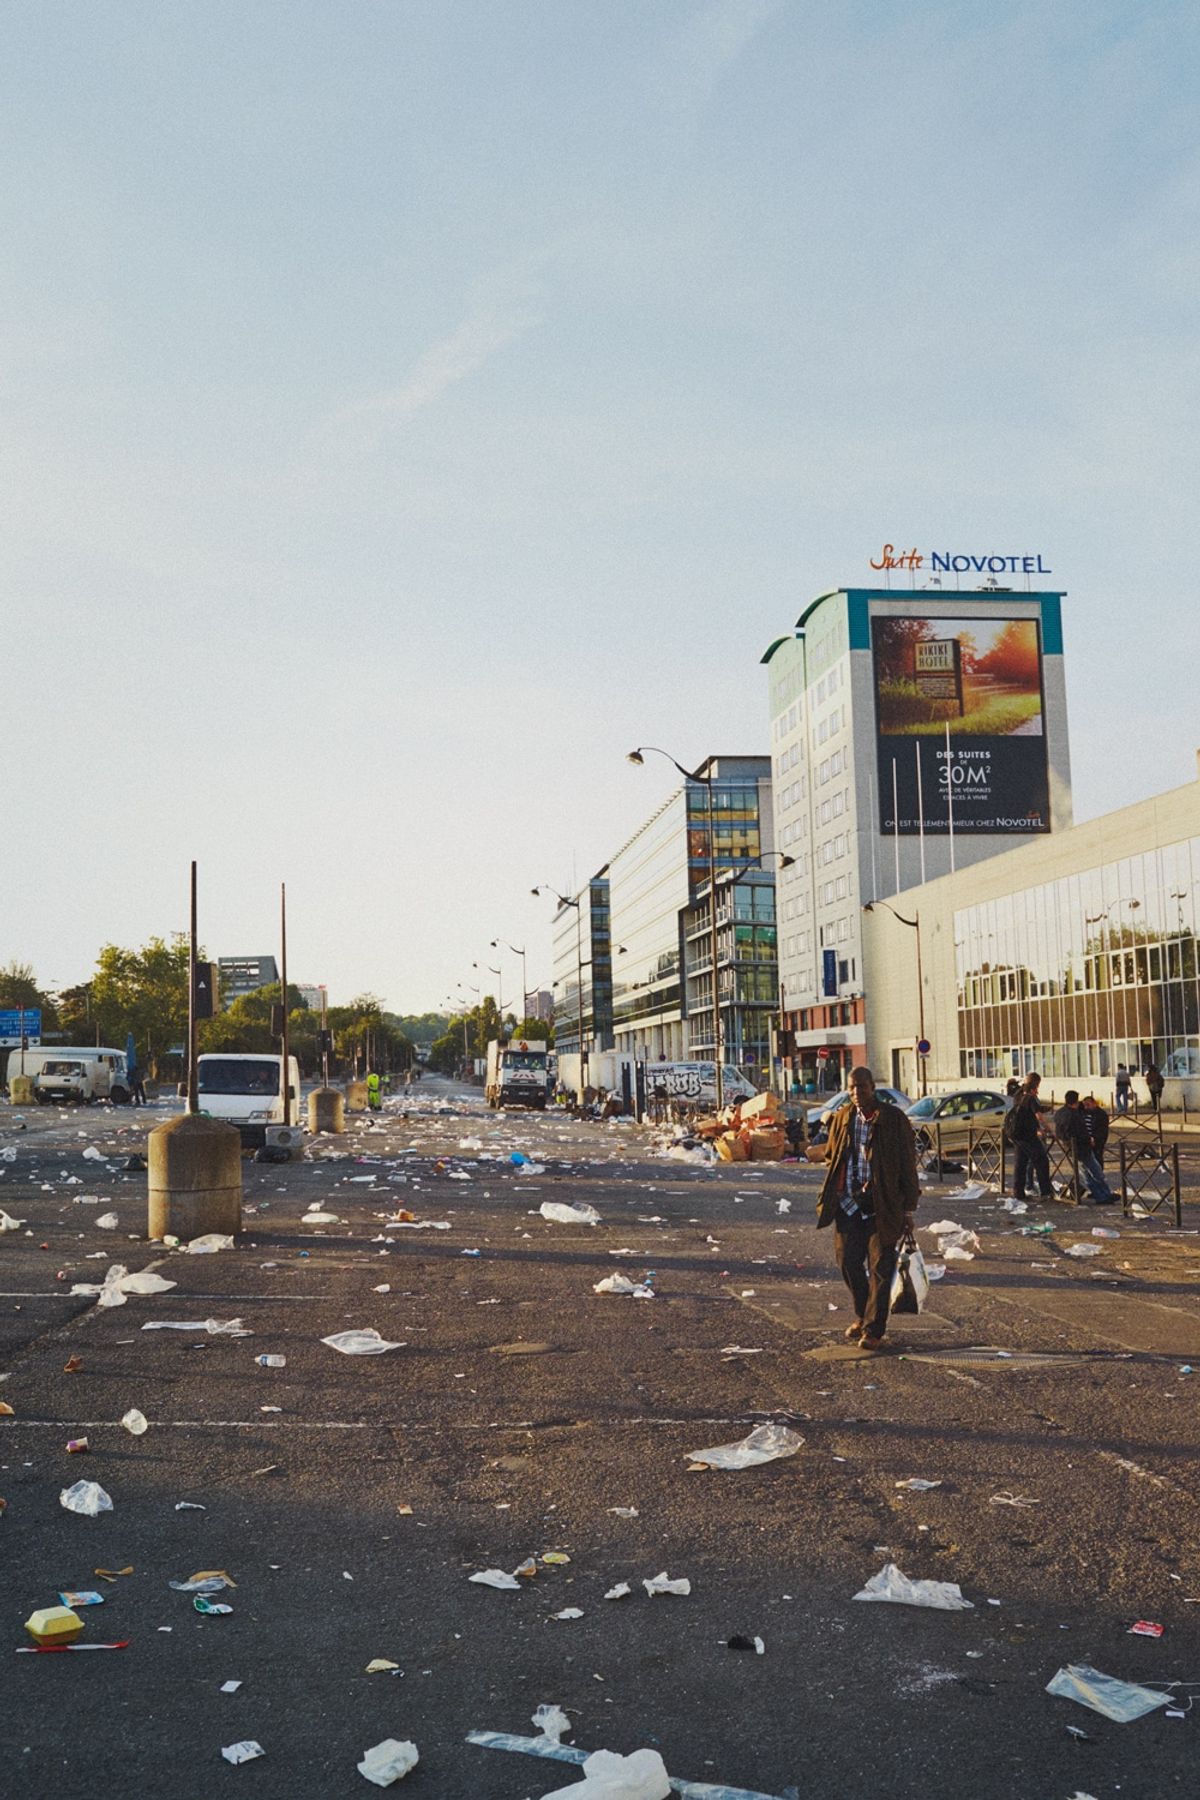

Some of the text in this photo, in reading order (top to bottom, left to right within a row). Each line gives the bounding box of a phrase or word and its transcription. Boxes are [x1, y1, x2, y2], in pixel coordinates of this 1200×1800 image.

[870, 544, 1051, 573] Suite NOVOTEL
[936, 751, 991, 759] DES SUITES
[996, 817, 1044, 827] NOVOTEL
